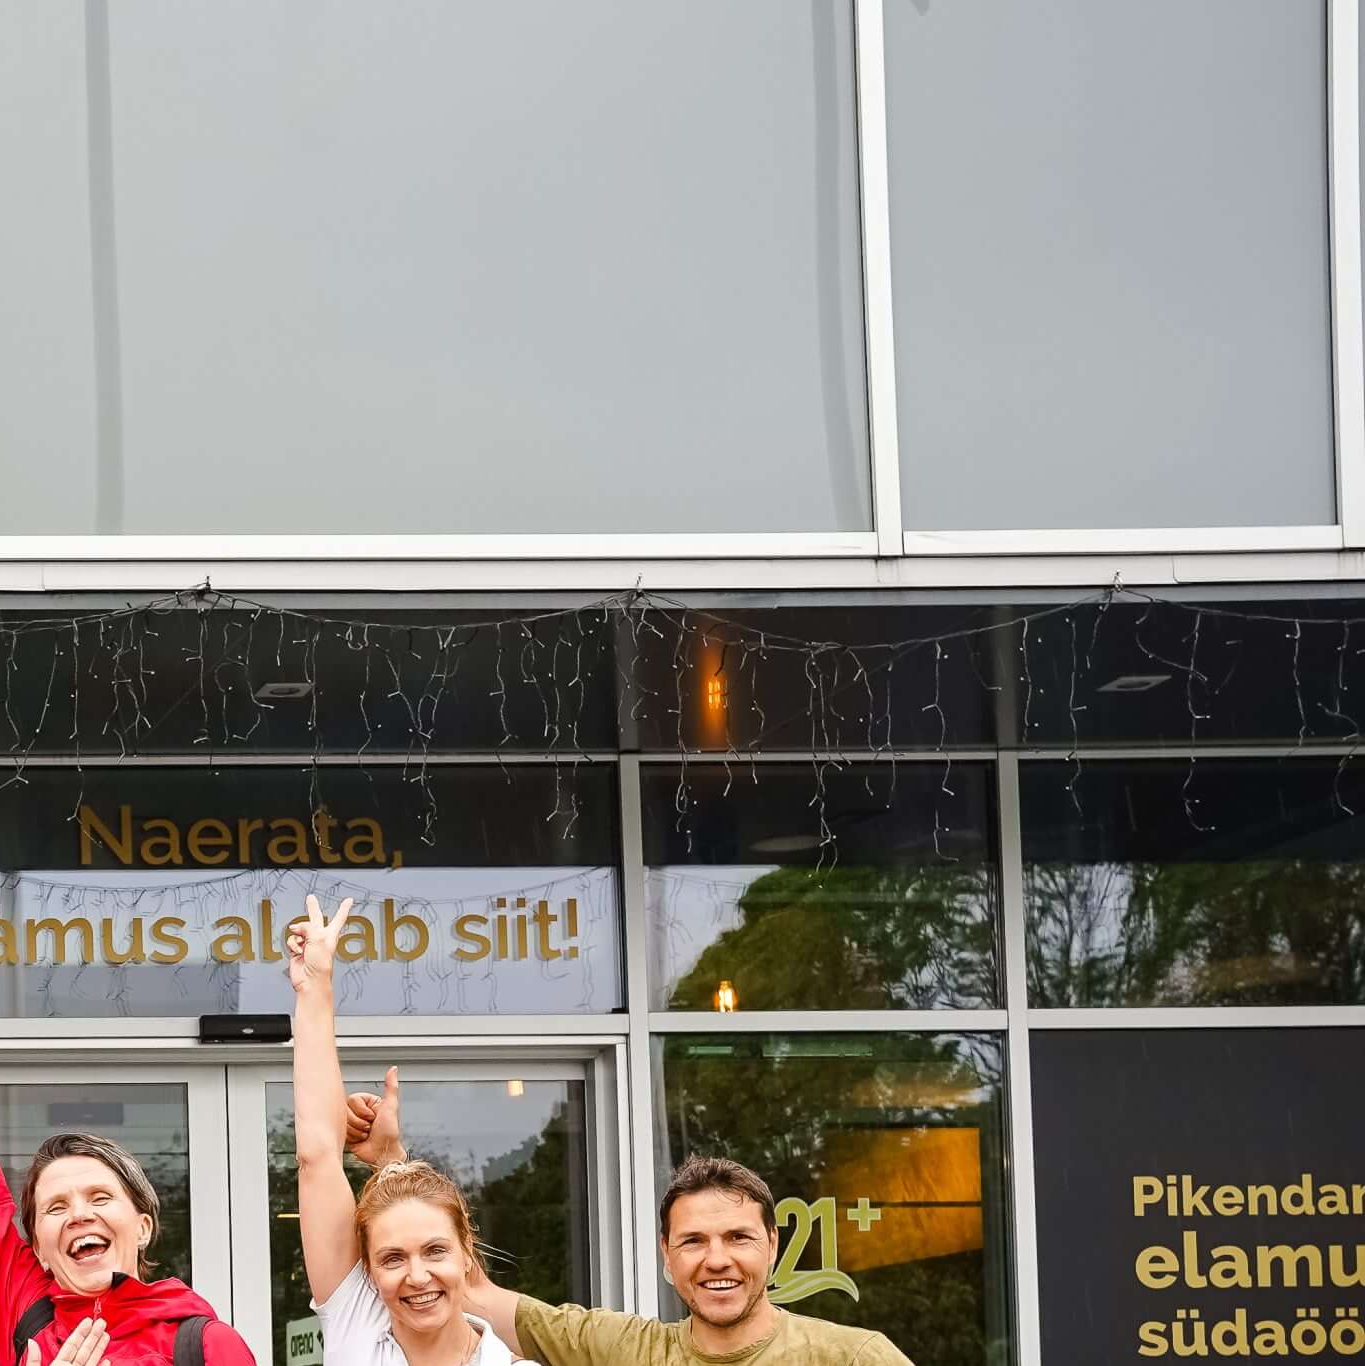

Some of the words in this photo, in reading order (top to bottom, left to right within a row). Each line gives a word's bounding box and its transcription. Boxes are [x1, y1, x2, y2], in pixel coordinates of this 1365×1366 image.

[80, 805, 402, 870] Naerata,
[451, 896, 578, 961] siit!
[1138, 1307, 1365, 1357] südaöö
